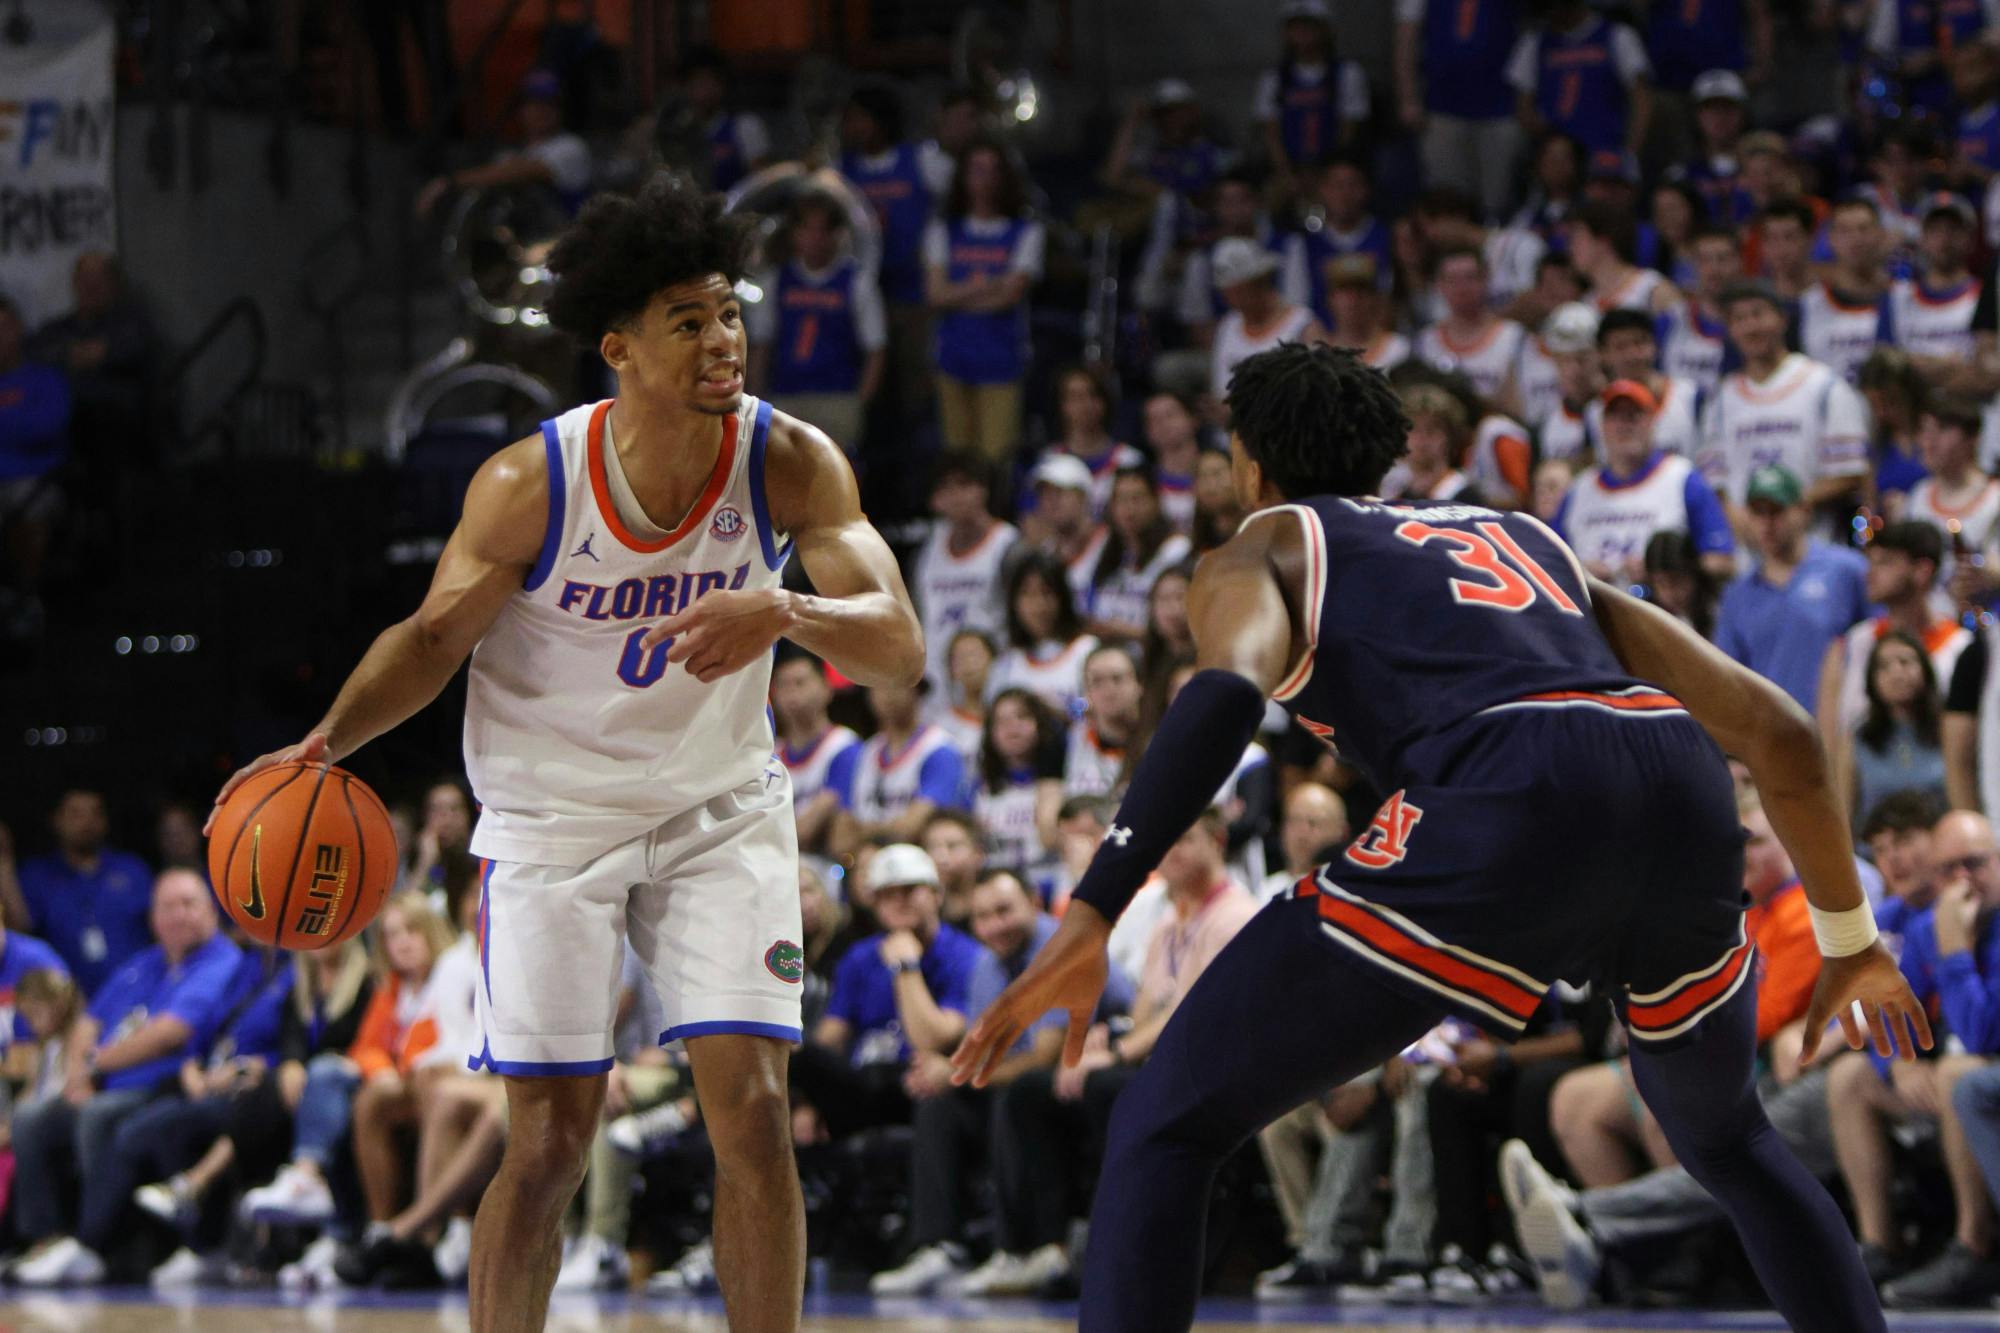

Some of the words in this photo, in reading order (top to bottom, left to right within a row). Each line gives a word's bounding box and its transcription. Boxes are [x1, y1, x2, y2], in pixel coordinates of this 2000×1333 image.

[715, 510, 739, 533] SEC
[1394, 521, 1584, 617] 31
[616, 626, 676, 688] 0
[295, 844, 342, 934] ELITE
